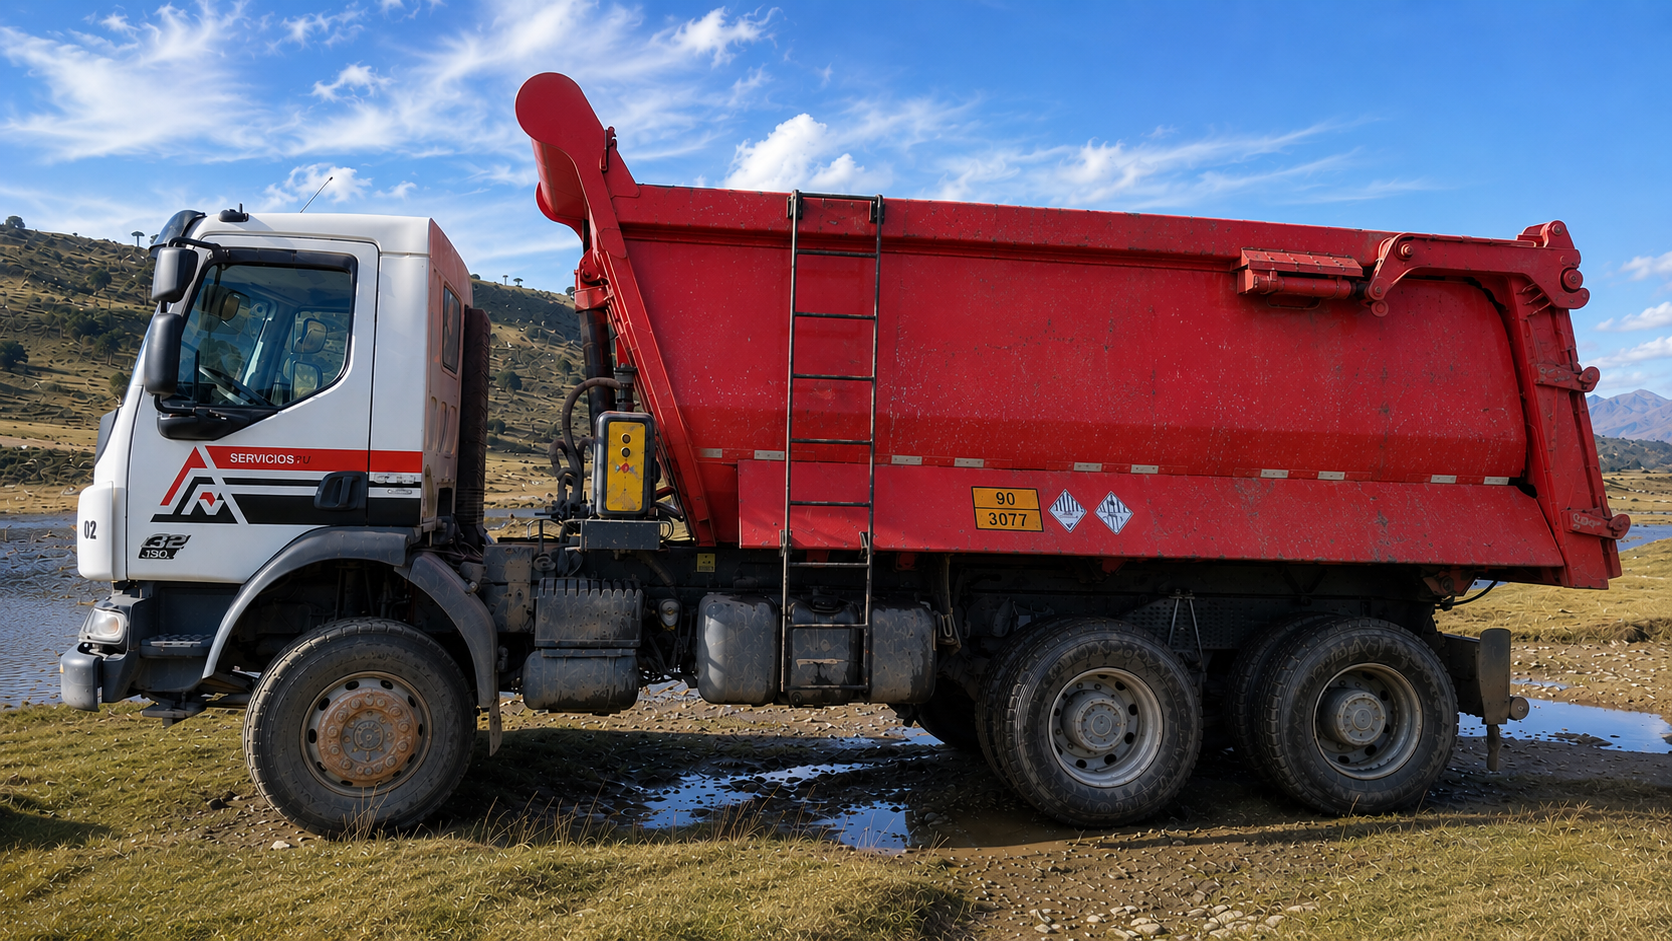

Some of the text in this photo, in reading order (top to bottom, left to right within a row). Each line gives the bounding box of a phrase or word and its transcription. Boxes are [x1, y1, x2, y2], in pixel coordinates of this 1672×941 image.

[230, 453, 295, 464] SERVICIOS
[996, 491, 1015, 505] 90
[988, 512, 1027, 526] 3077
[84, 520, 97, 539] 02
